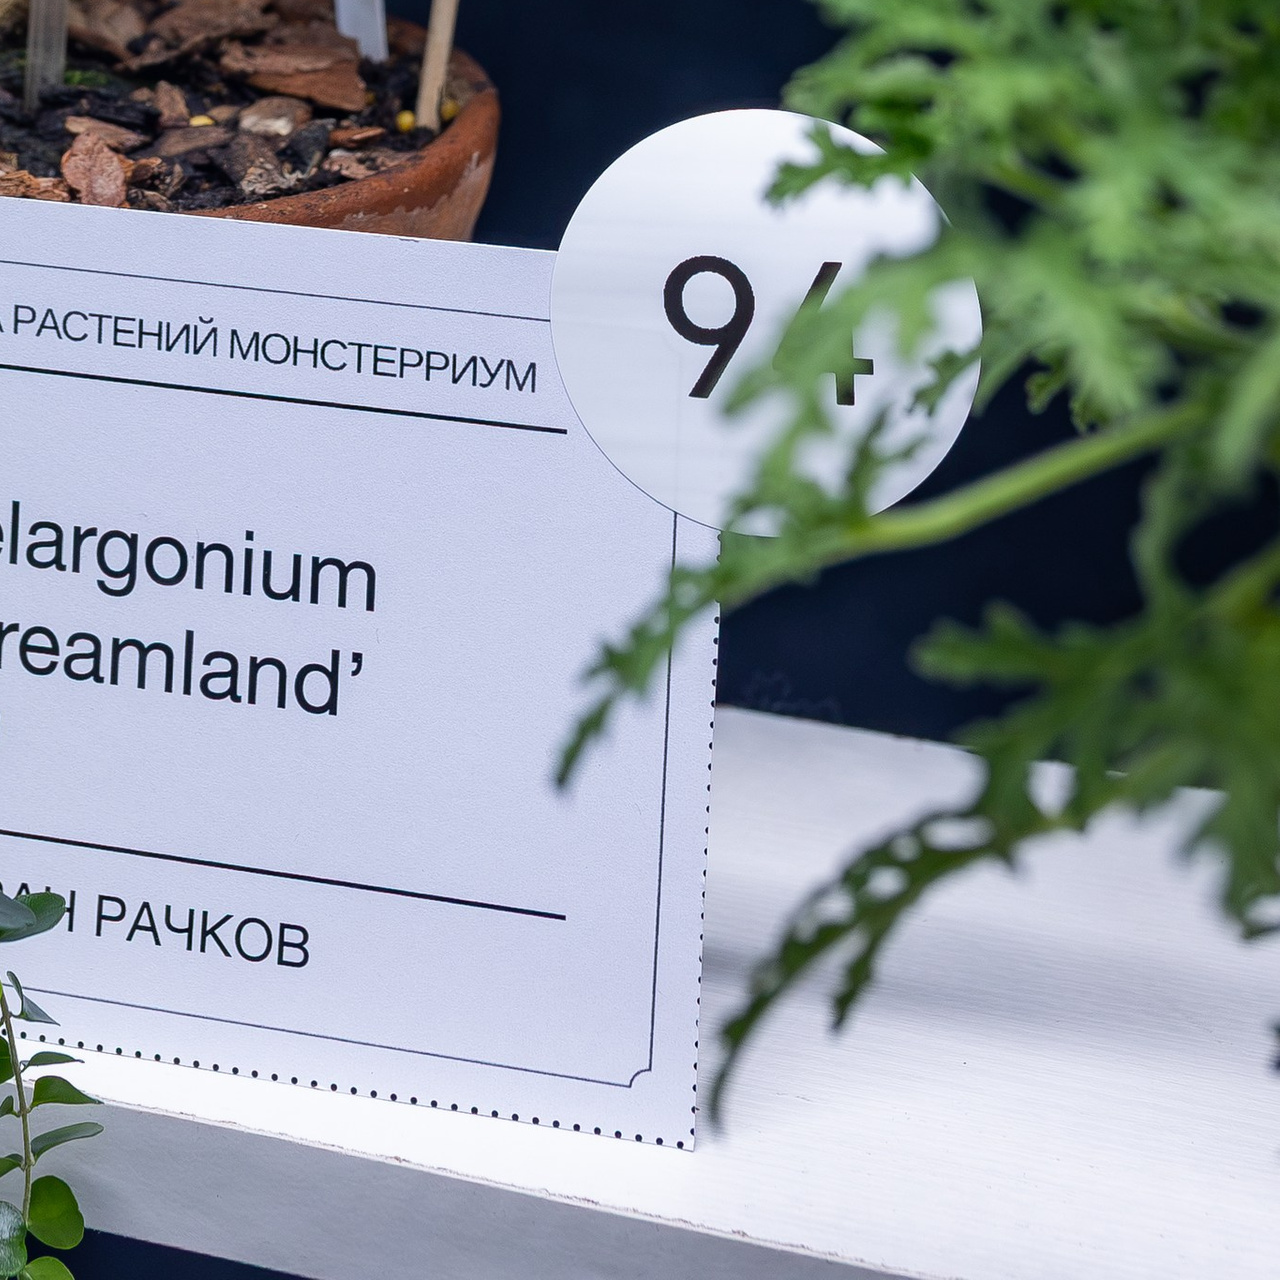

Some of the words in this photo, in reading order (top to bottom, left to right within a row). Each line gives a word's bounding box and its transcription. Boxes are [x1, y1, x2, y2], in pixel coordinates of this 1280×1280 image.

[13, 304, 218, 358] РАСТЕНИЙ
[229, 328, 537, 394] МОНСТЕРРИУМ
[95, 894, 310, 968] РАЧКОВ
